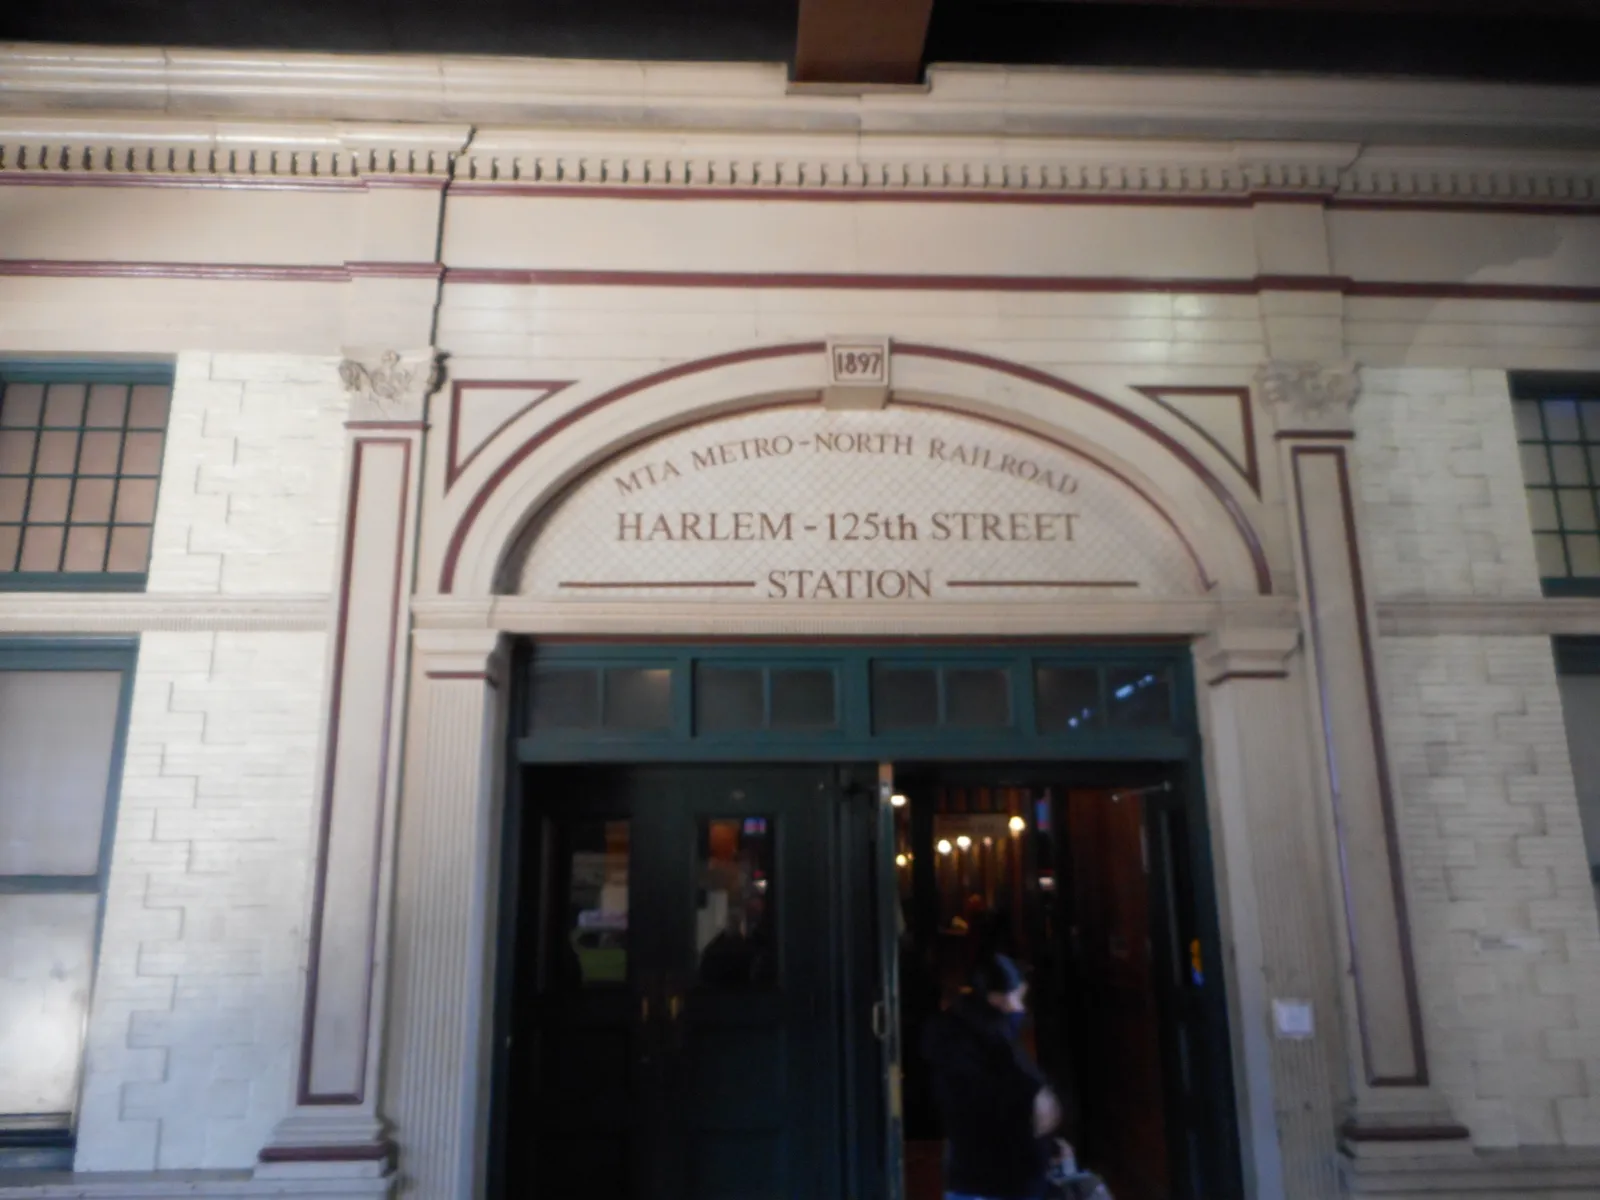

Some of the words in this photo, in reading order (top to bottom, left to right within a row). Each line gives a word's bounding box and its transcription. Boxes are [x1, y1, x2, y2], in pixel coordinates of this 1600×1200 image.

[837, 352, 881, 375] 1897
[614, 460, 681, 496] MTA
[929, 437, 1079, 496] RAILROAD
[930, 512, 1079, 542] STREET
[768, 569, 933, 600] STATION
